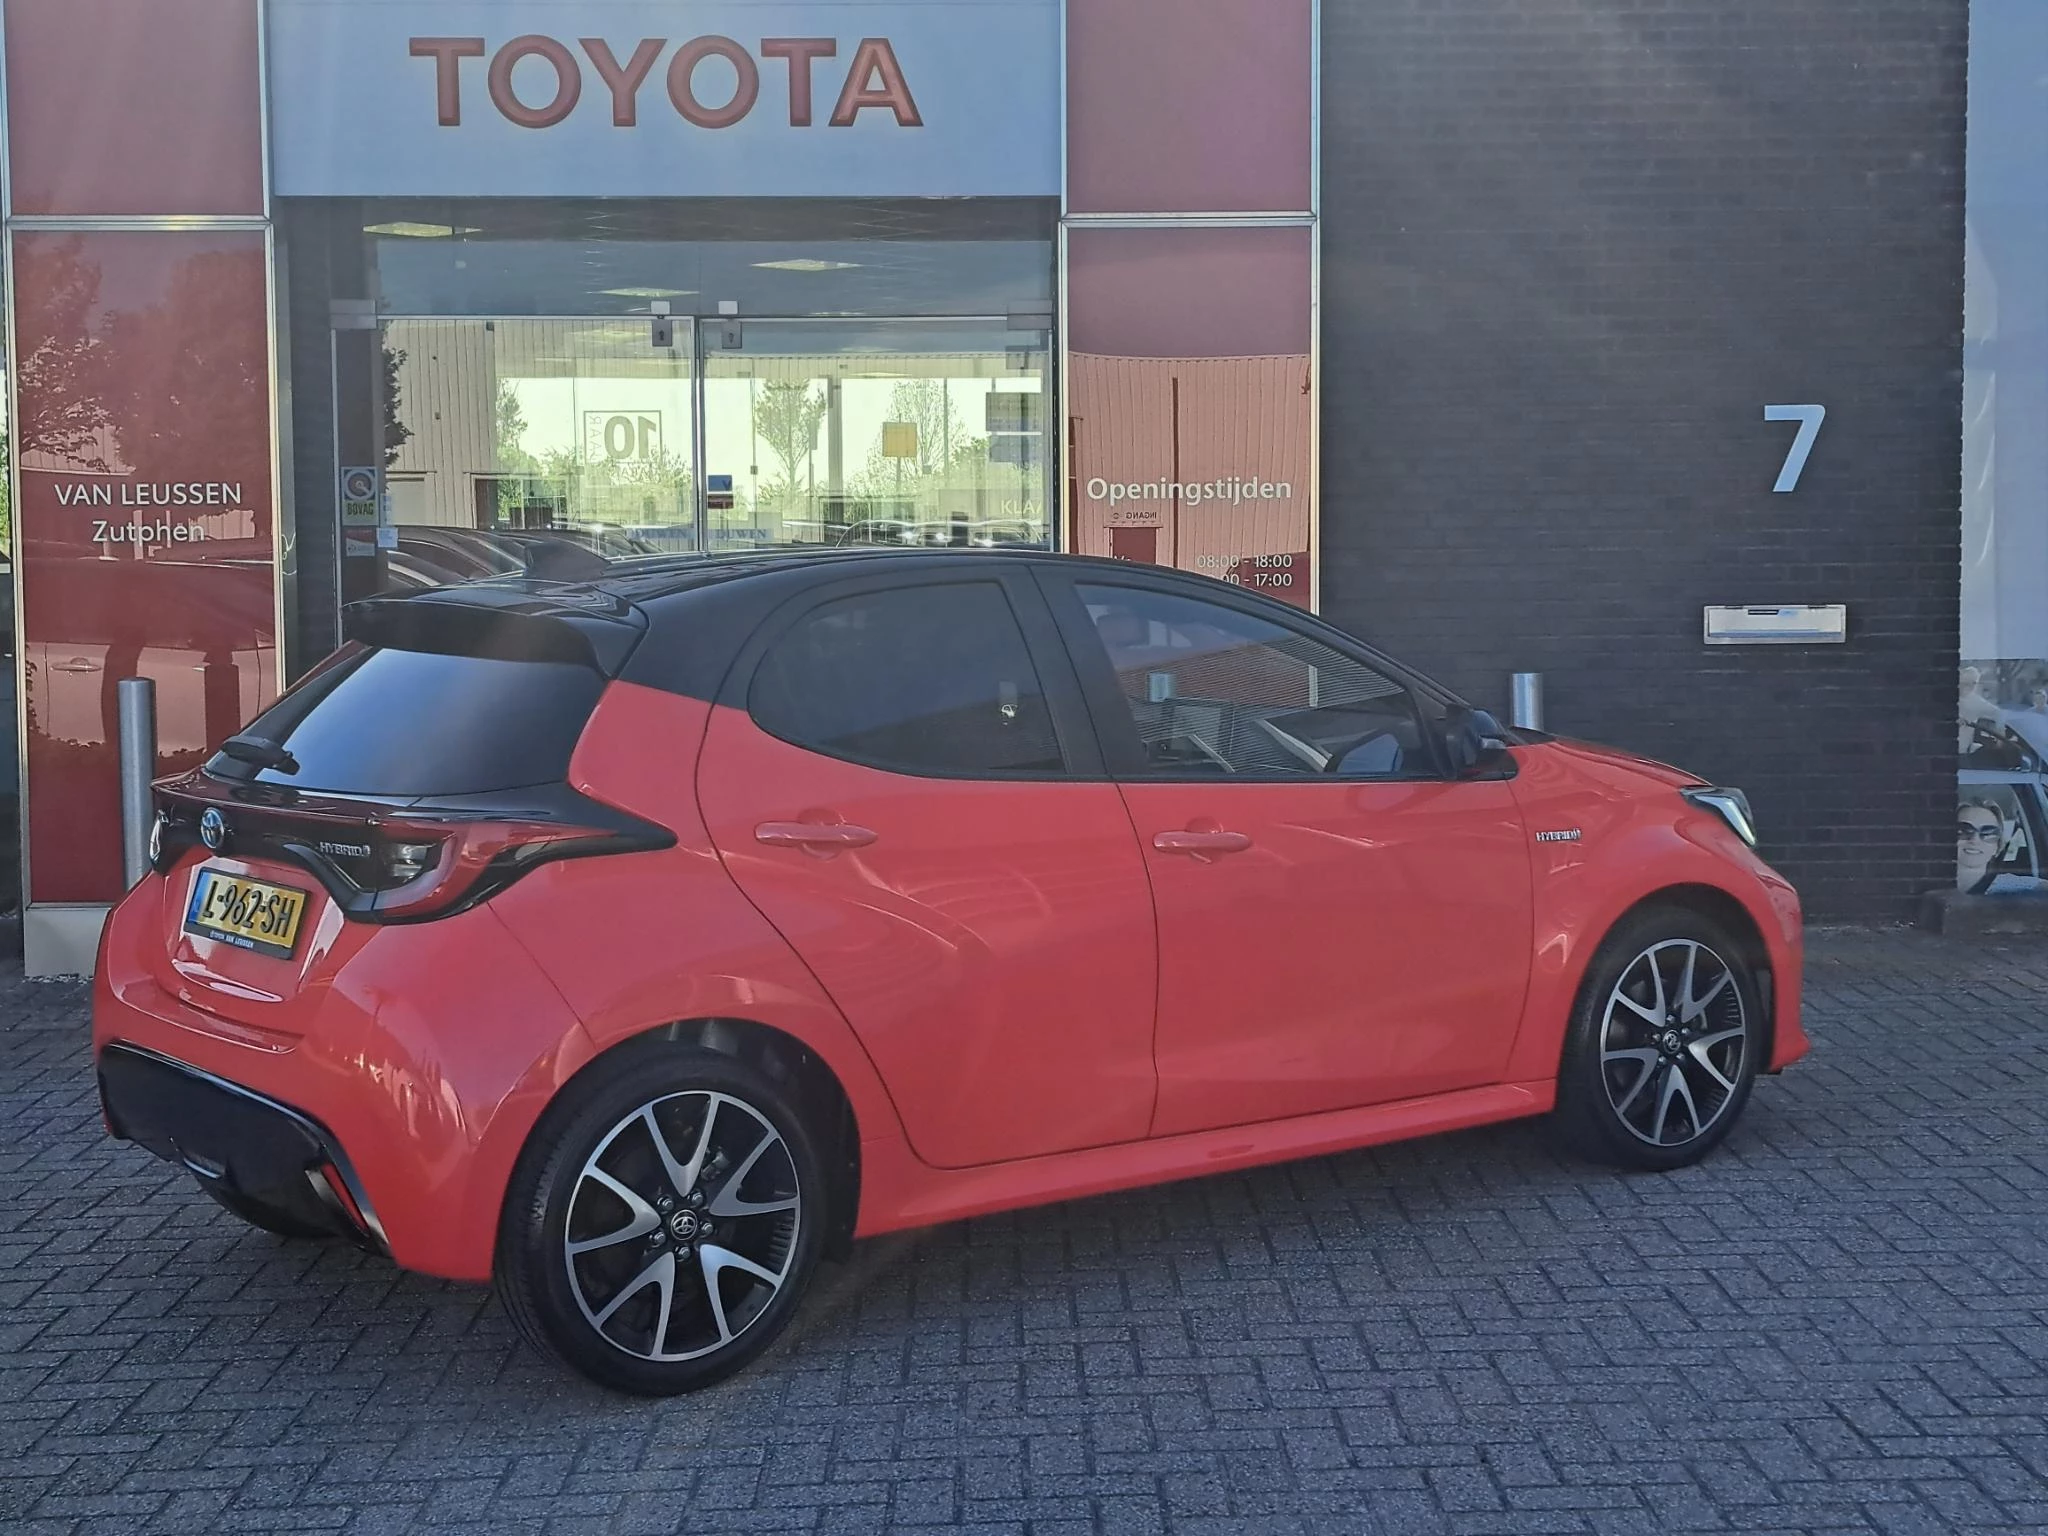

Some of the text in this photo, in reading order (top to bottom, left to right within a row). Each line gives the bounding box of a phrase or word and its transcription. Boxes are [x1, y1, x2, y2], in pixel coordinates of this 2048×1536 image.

[409, 34, 924, 128] TOYOTA
[1764, 404, 1826, 492] 7
[54, 483, 241, 505] VAN LEUSSEN
[1086, 476, 1292, 506] Openingstijden
[347, 502, 374, 515] BOVAG
[92, 519, 205, 547] Zutphen
[1196, 554, 1240, 568] 08:00
[1254, 554, 1293, 568] 18:00
[1254, 573, 1293, 587] 17:00
[1536, 831, 1575, 841] HYBRID
[320, 841, 363, 857] HYBRID
[202, 880, 296, 938] L-962-SH
